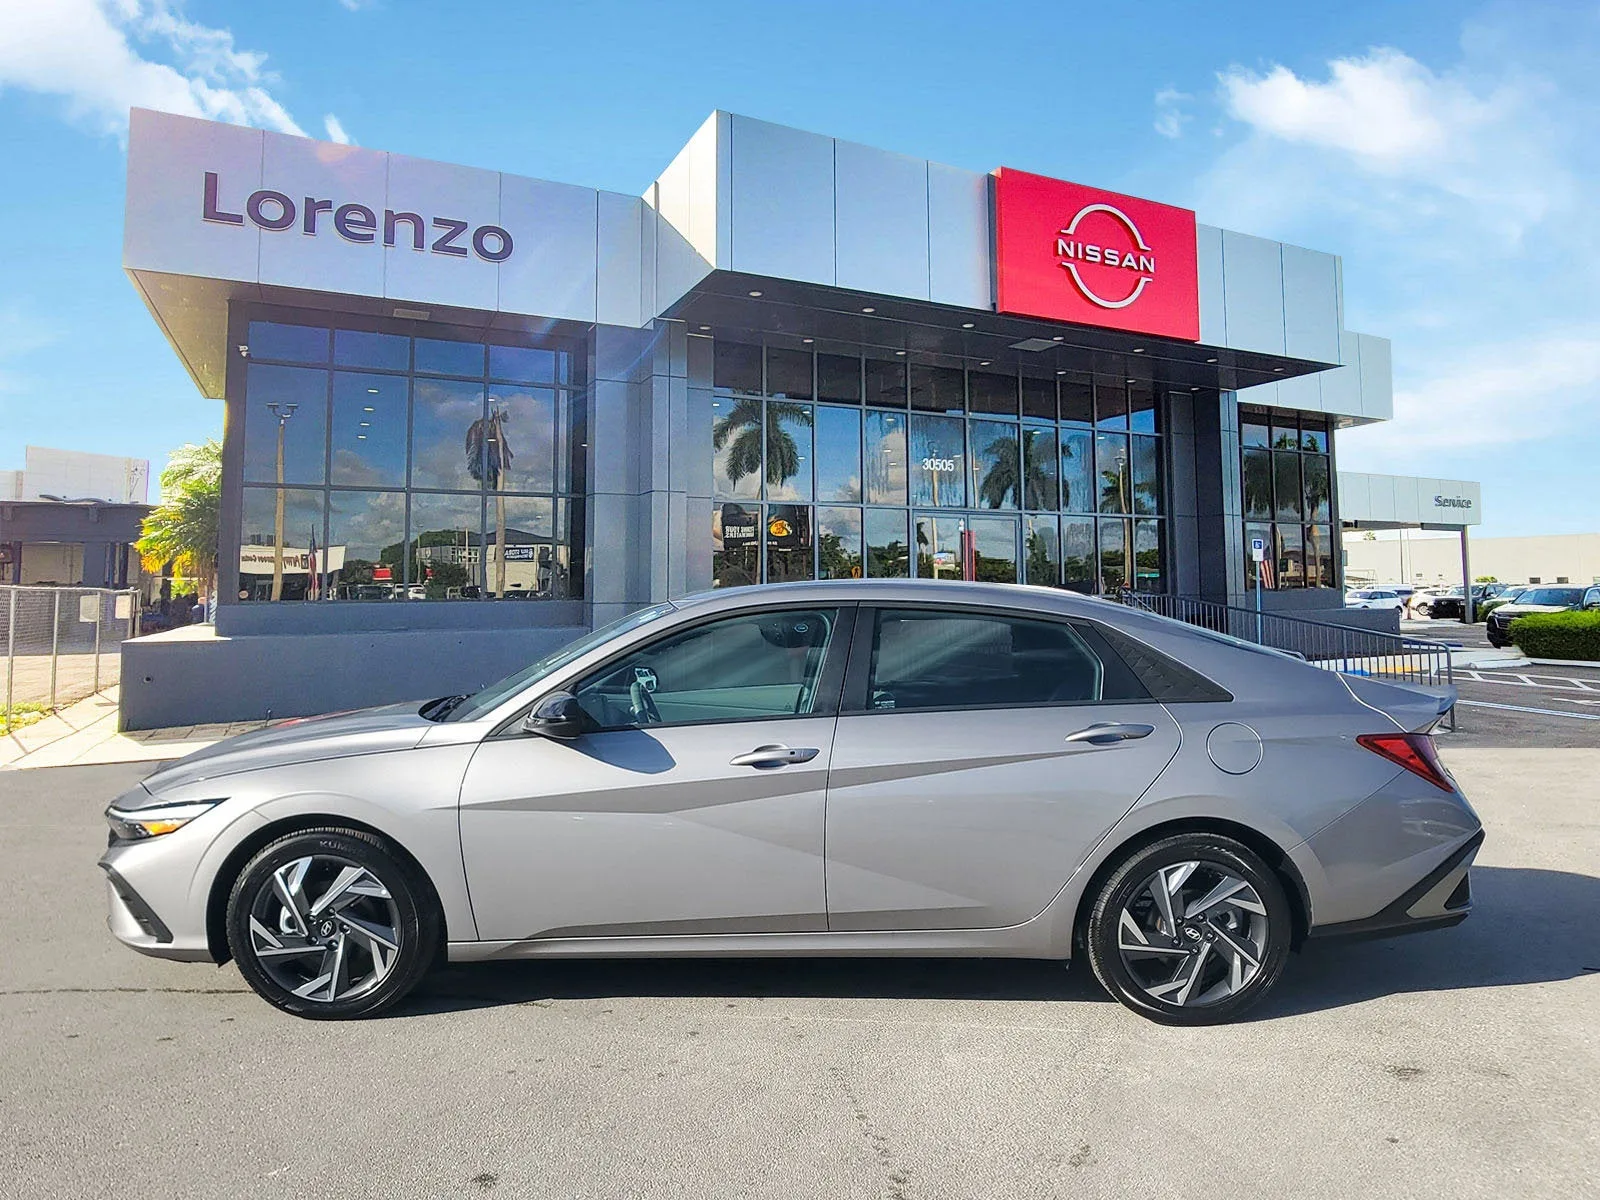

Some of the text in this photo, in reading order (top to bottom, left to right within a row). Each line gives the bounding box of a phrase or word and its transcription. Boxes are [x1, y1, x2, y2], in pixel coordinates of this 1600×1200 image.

[202, 171, 514, 263] Lorenzo
[1057, 238, 1155, 273] NISSAN
[922, 458, 955, 471] 30505
[1434, 495, 1472, 509] Service
